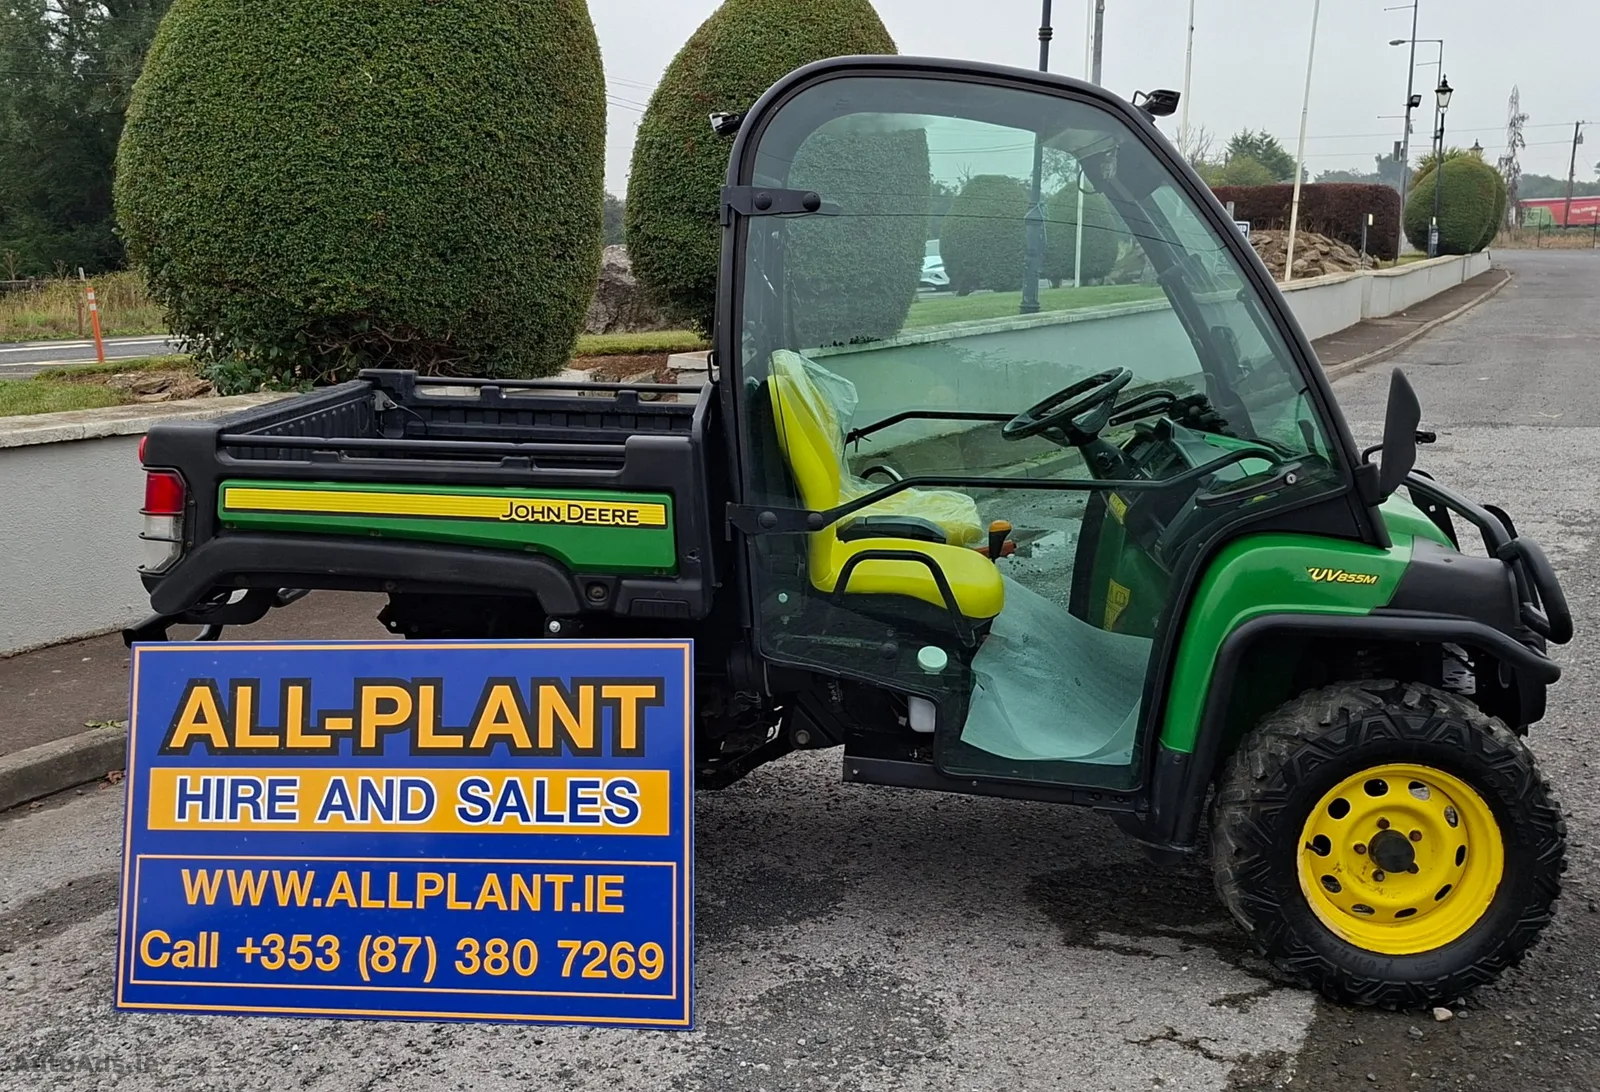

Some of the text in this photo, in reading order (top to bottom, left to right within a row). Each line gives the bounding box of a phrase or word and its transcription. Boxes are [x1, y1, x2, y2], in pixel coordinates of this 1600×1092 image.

[502, 501, 639, 524] JOHN DEERE
[167, 684, 658, 751] ALL-PLANT
[177, 777, 640, 826] HIRE AND SALES
[182, 869, 625, 912] WWW.ALLPLANT.IE
[140, 930, 665, 982] Call +353 (87) 380 7269
